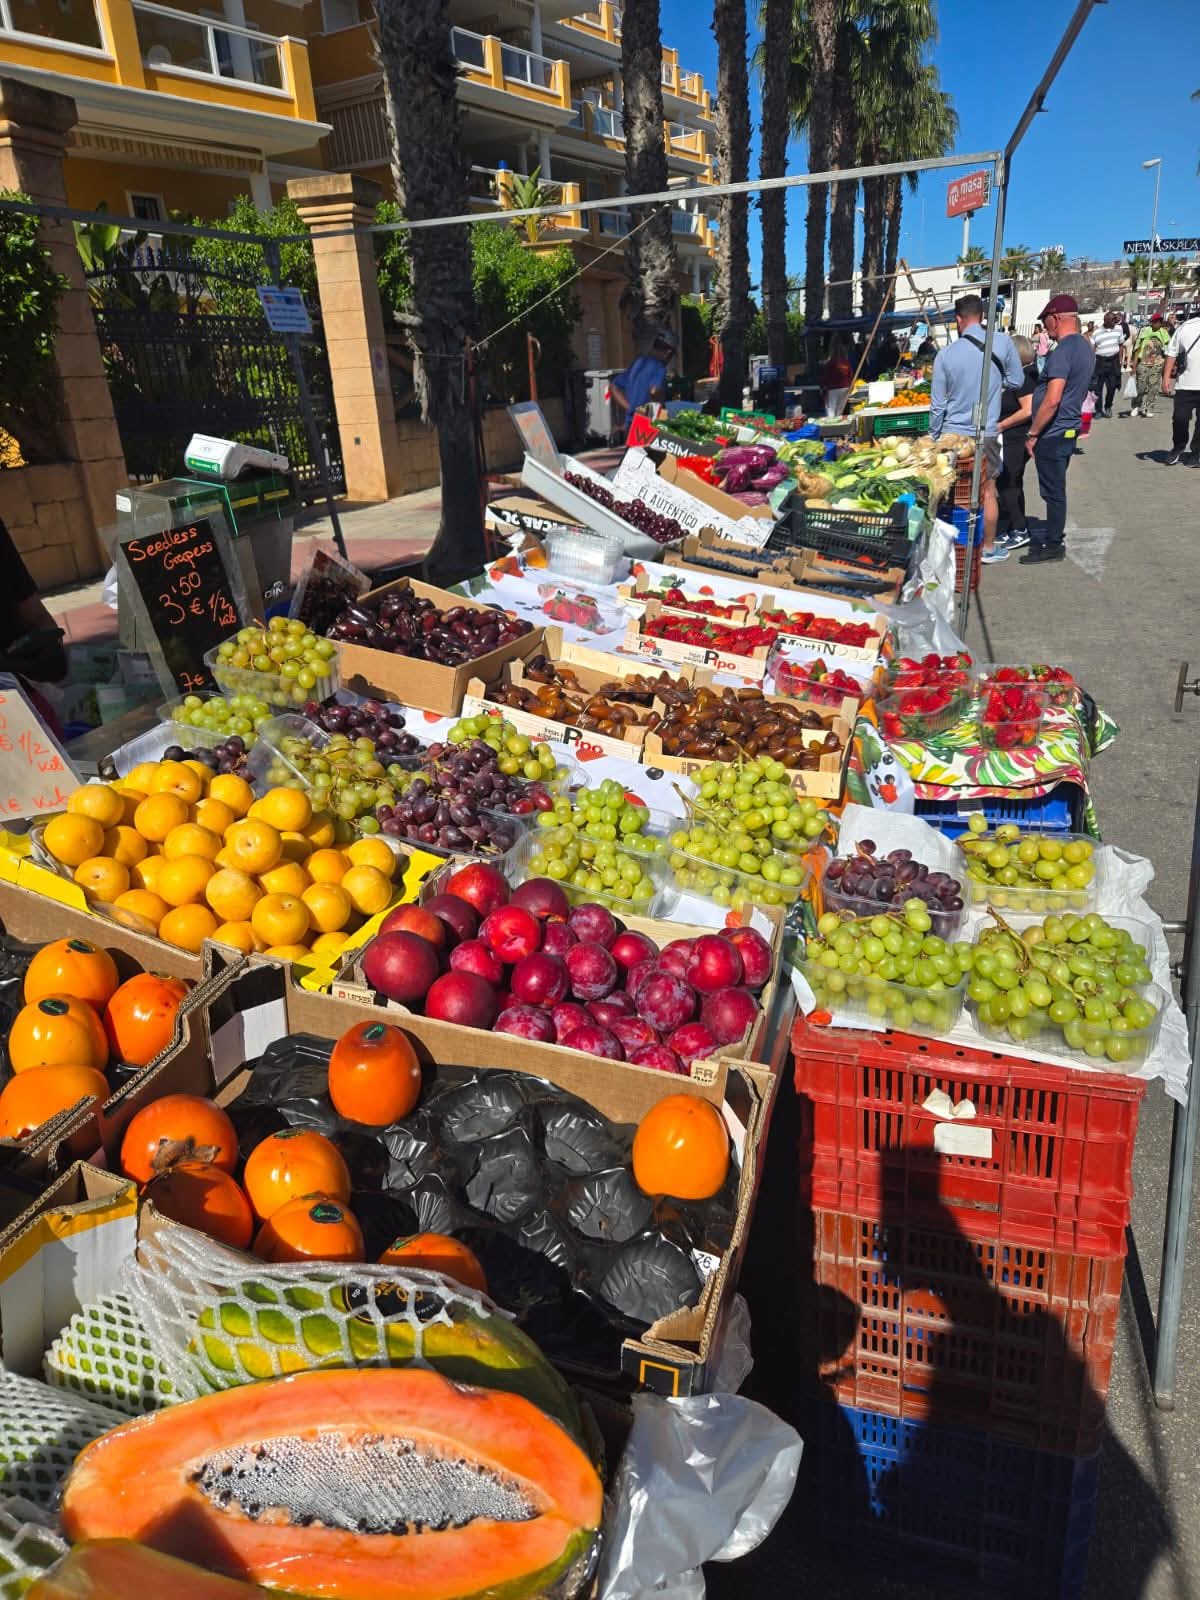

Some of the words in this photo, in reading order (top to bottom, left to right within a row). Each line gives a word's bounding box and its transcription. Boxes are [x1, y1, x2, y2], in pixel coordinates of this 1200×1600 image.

[960, 177, 982, 194] masa
[1127, 242, 1151, 253] NEW
[1161, 240, 1198, 251] SKALA
[638, 486, 648, 499] EL
[128, 526, 198, 561] Seedless
[208, 589, 230, 622] 1/2
[703, 649, 736, 671] Pipo
[18, 729, 49, 767] 1/2
[562, 726, 604, 753] Pipo
